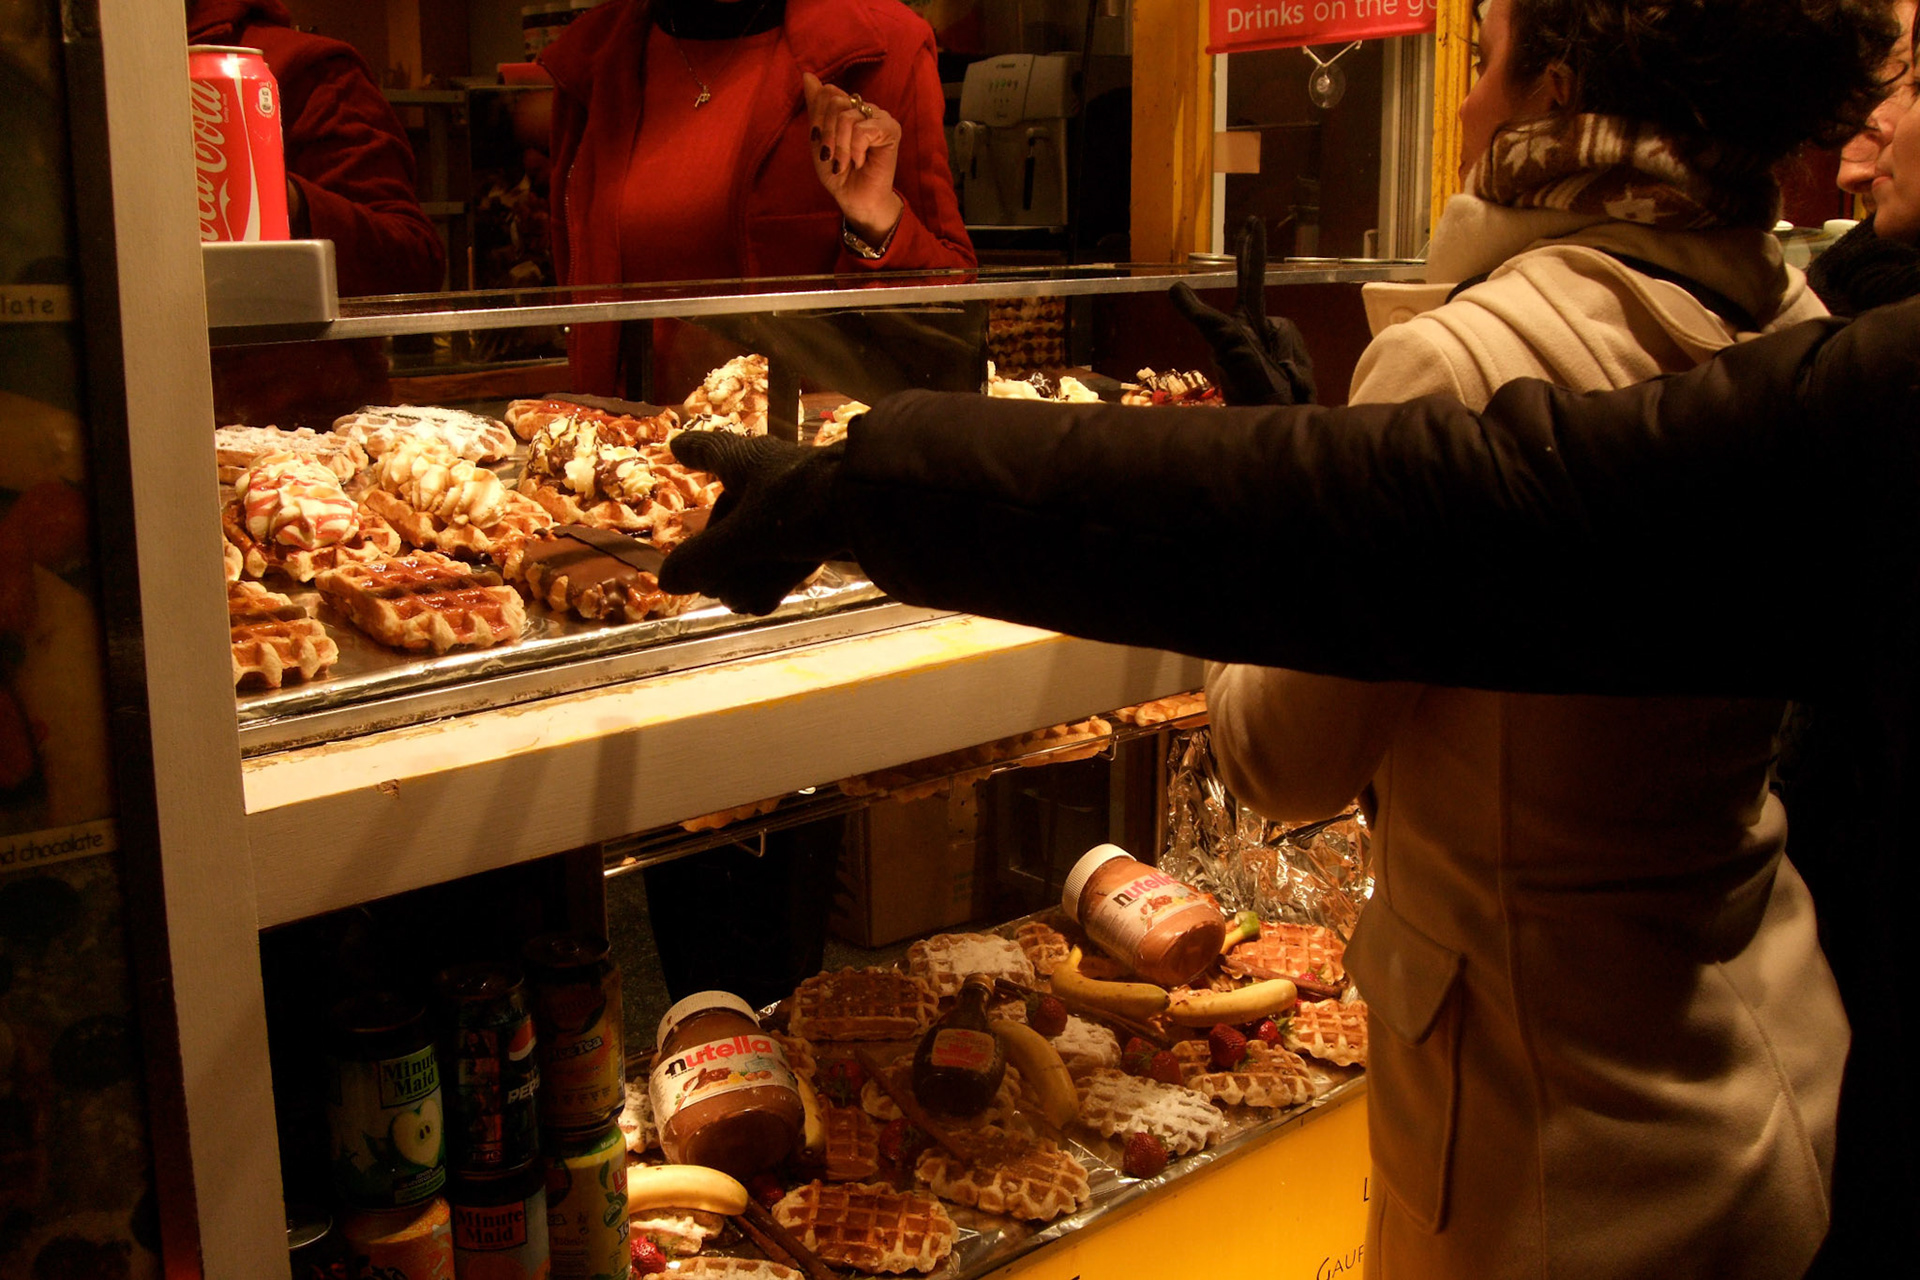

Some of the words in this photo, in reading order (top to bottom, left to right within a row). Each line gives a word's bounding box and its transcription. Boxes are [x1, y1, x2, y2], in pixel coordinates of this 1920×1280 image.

[1227, 1, 1304, 33] Drinks
[1314, 1, 1346, 21] on
[1354, 0, 1398, 18] the
[20, 832, 104, 861] chocolate
[382, 1052, 436, 1081] Minut
[665, 1035, 773, 1076] nutella
[394, 1067, 435, 1097] Maid
[456, 1210, 523, 1227] Minute
[465, 1227, 513, 1243] Maid
